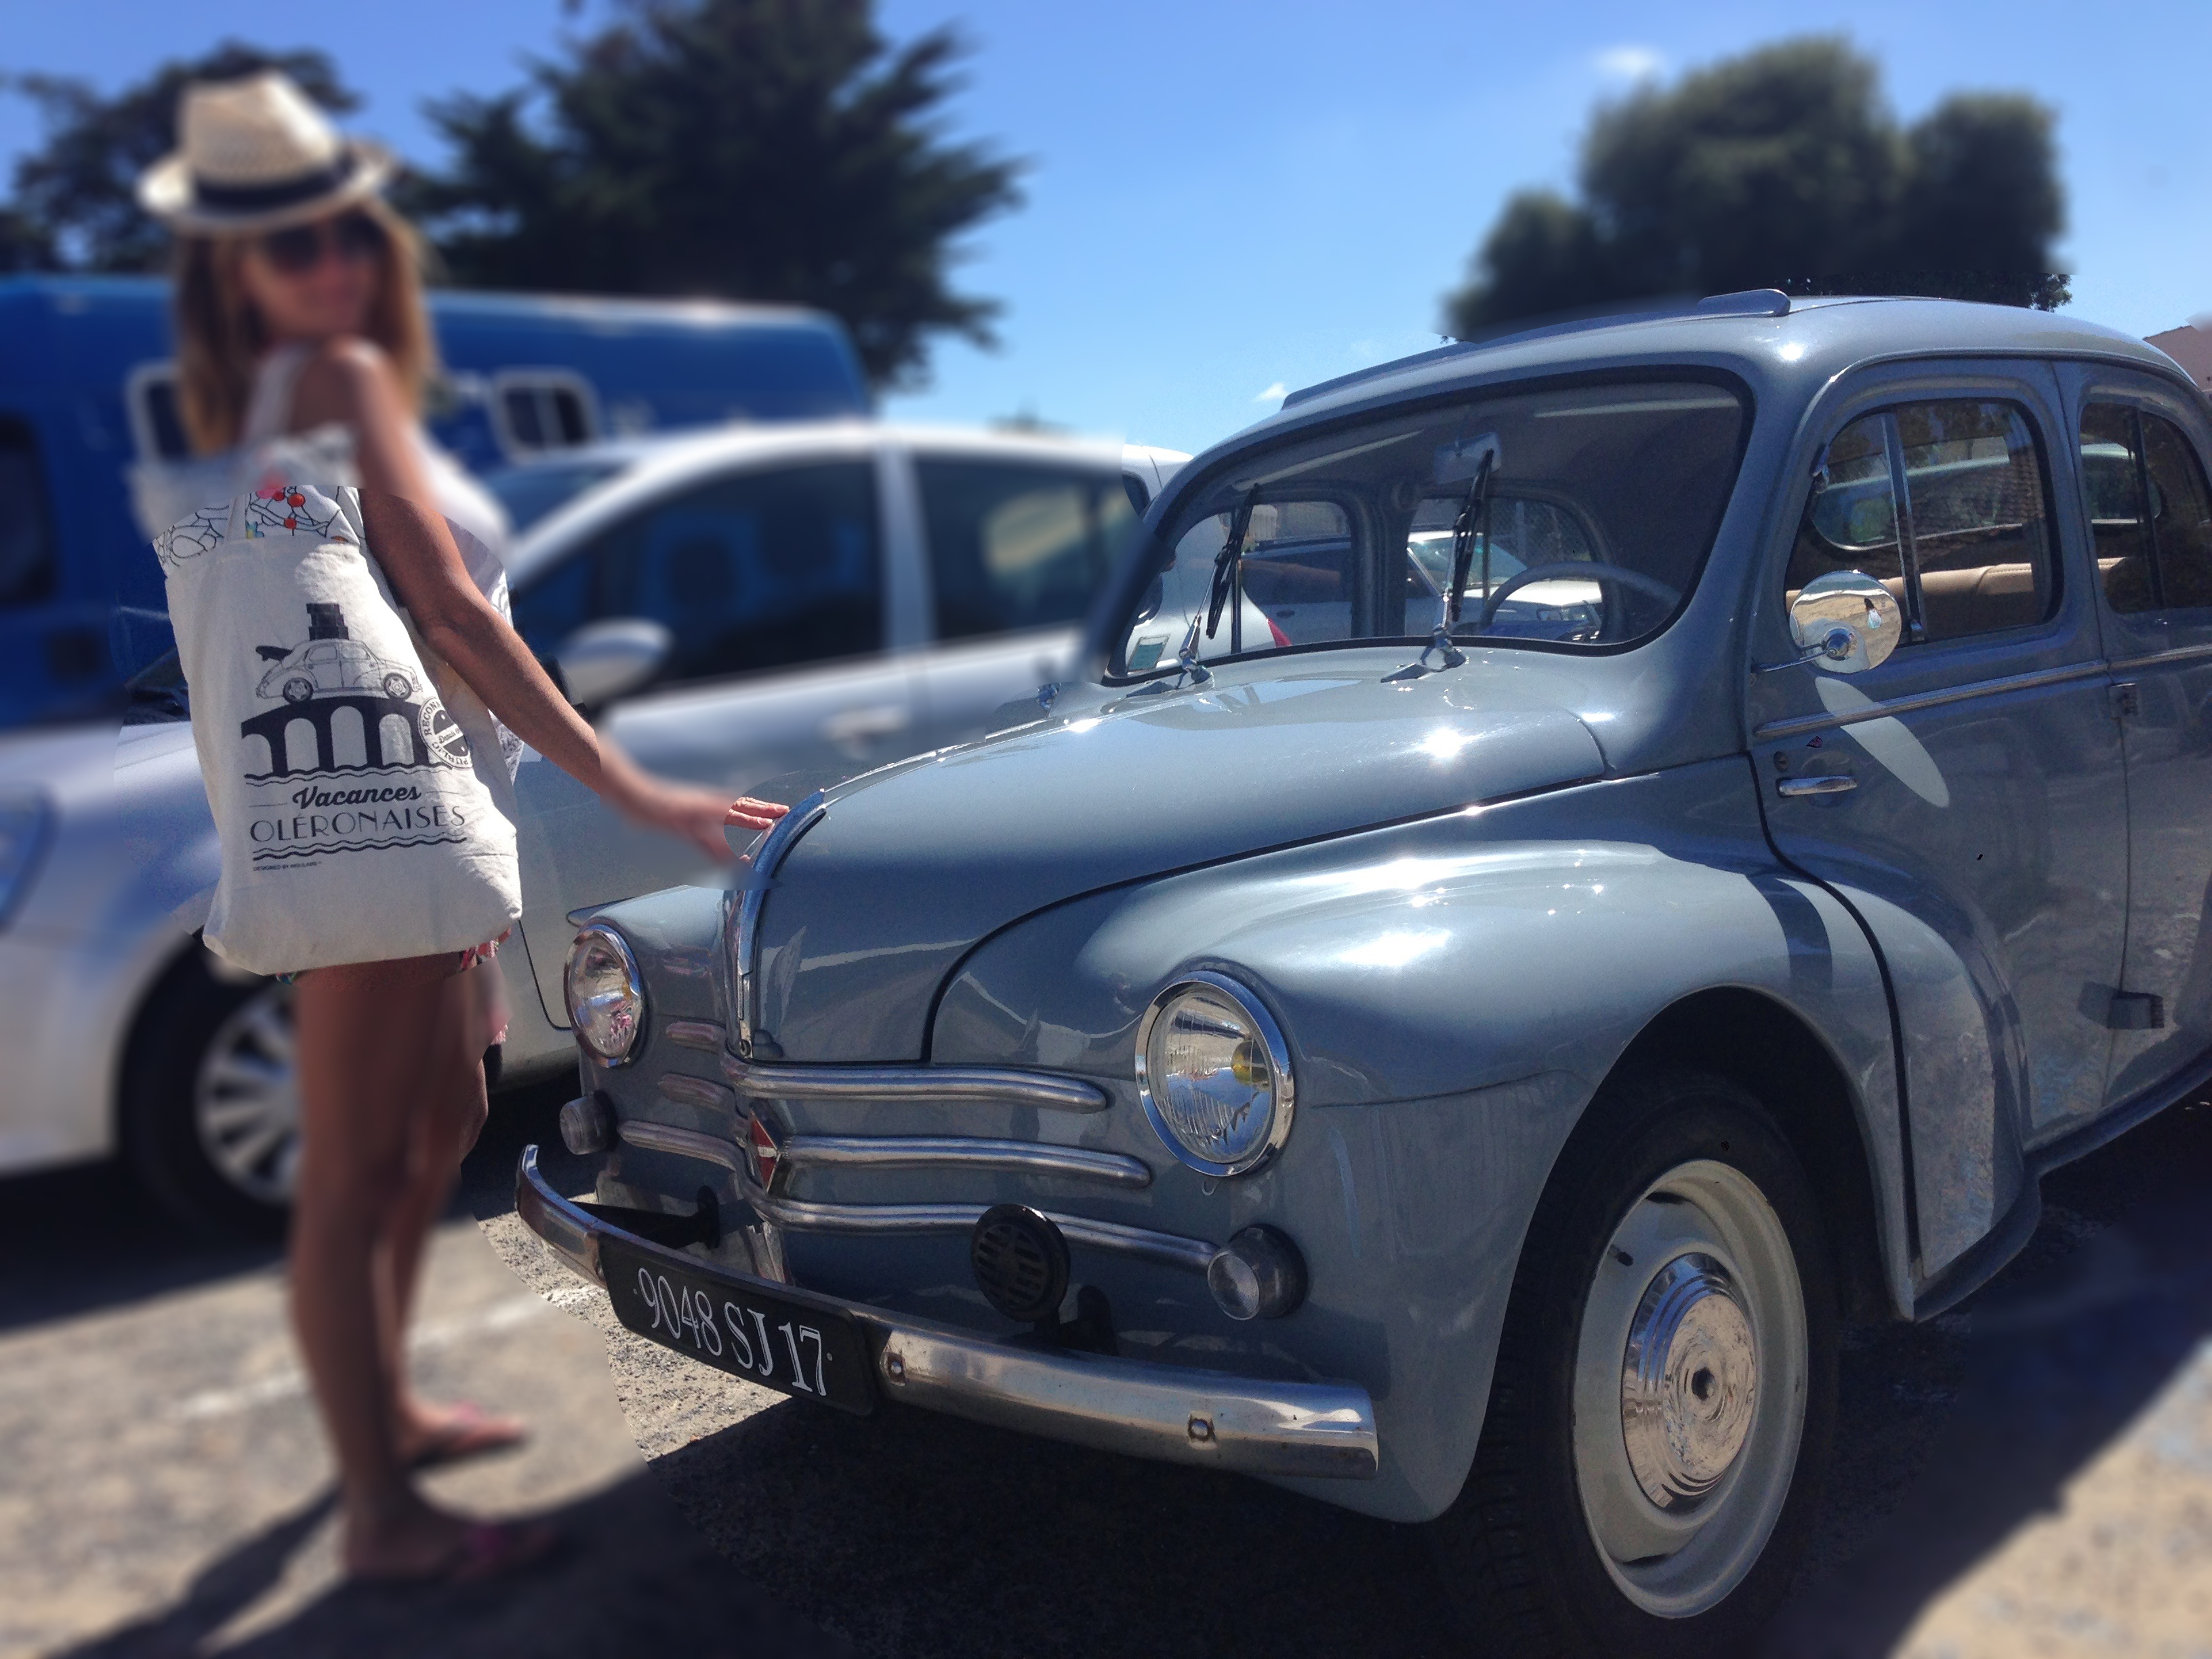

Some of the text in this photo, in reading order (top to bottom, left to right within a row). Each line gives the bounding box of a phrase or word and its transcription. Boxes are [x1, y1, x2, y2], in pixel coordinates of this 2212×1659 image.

[292, 785, 422, 809] Vacances
[249, 805, 466, 842] OLÉRONAISES
[638, 1267, 827, 1397] 9048 SJ 17
